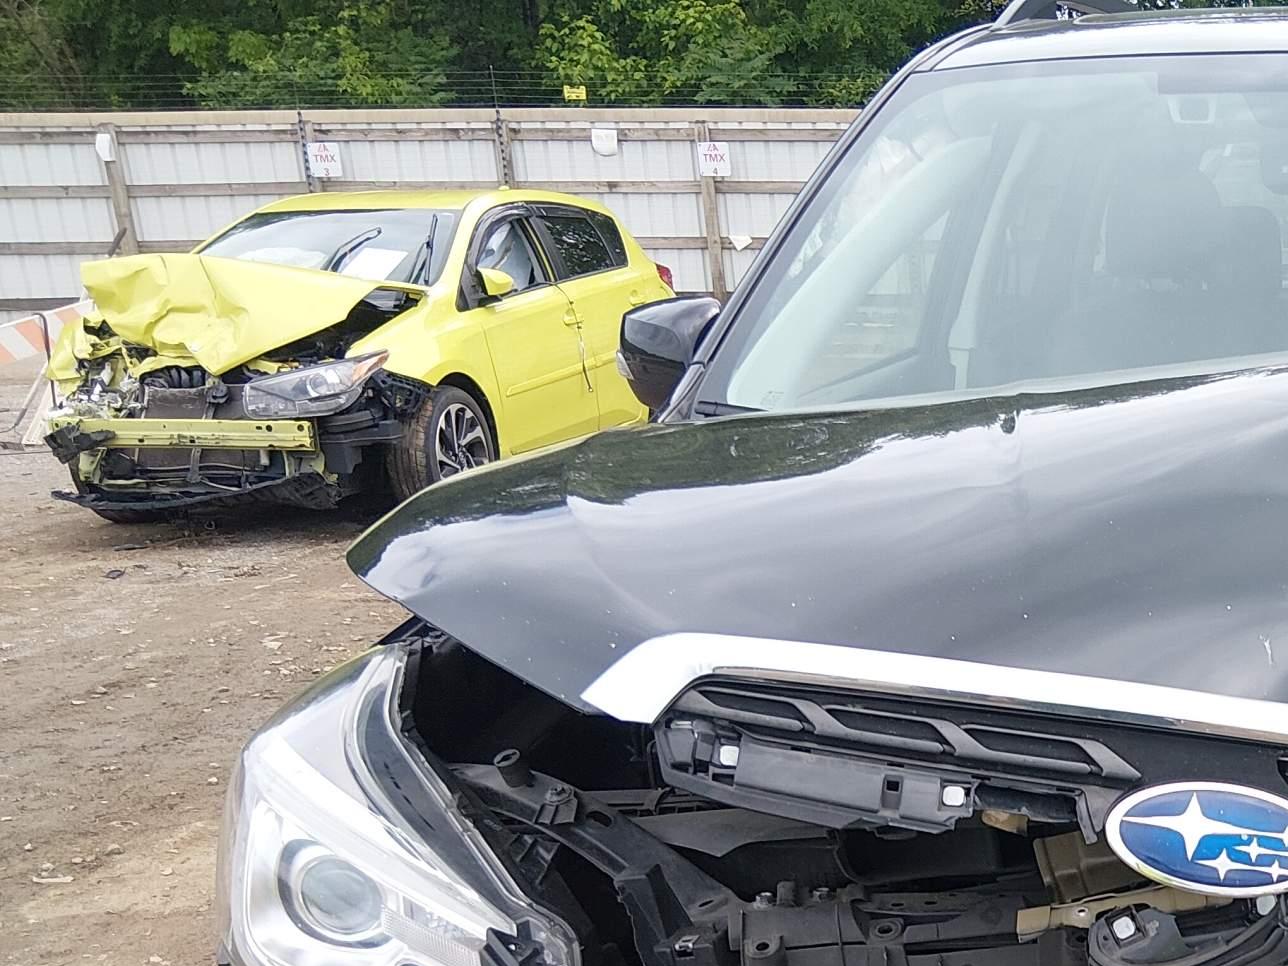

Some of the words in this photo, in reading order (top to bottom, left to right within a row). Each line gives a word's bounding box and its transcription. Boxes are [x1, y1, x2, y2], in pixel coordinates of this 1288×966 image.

[312, 154, 337, 163] TMX
[703, 153, 727, 163] TMX
[323, 167, 330, 176] 3
[712, 167, 719, 175] 4
